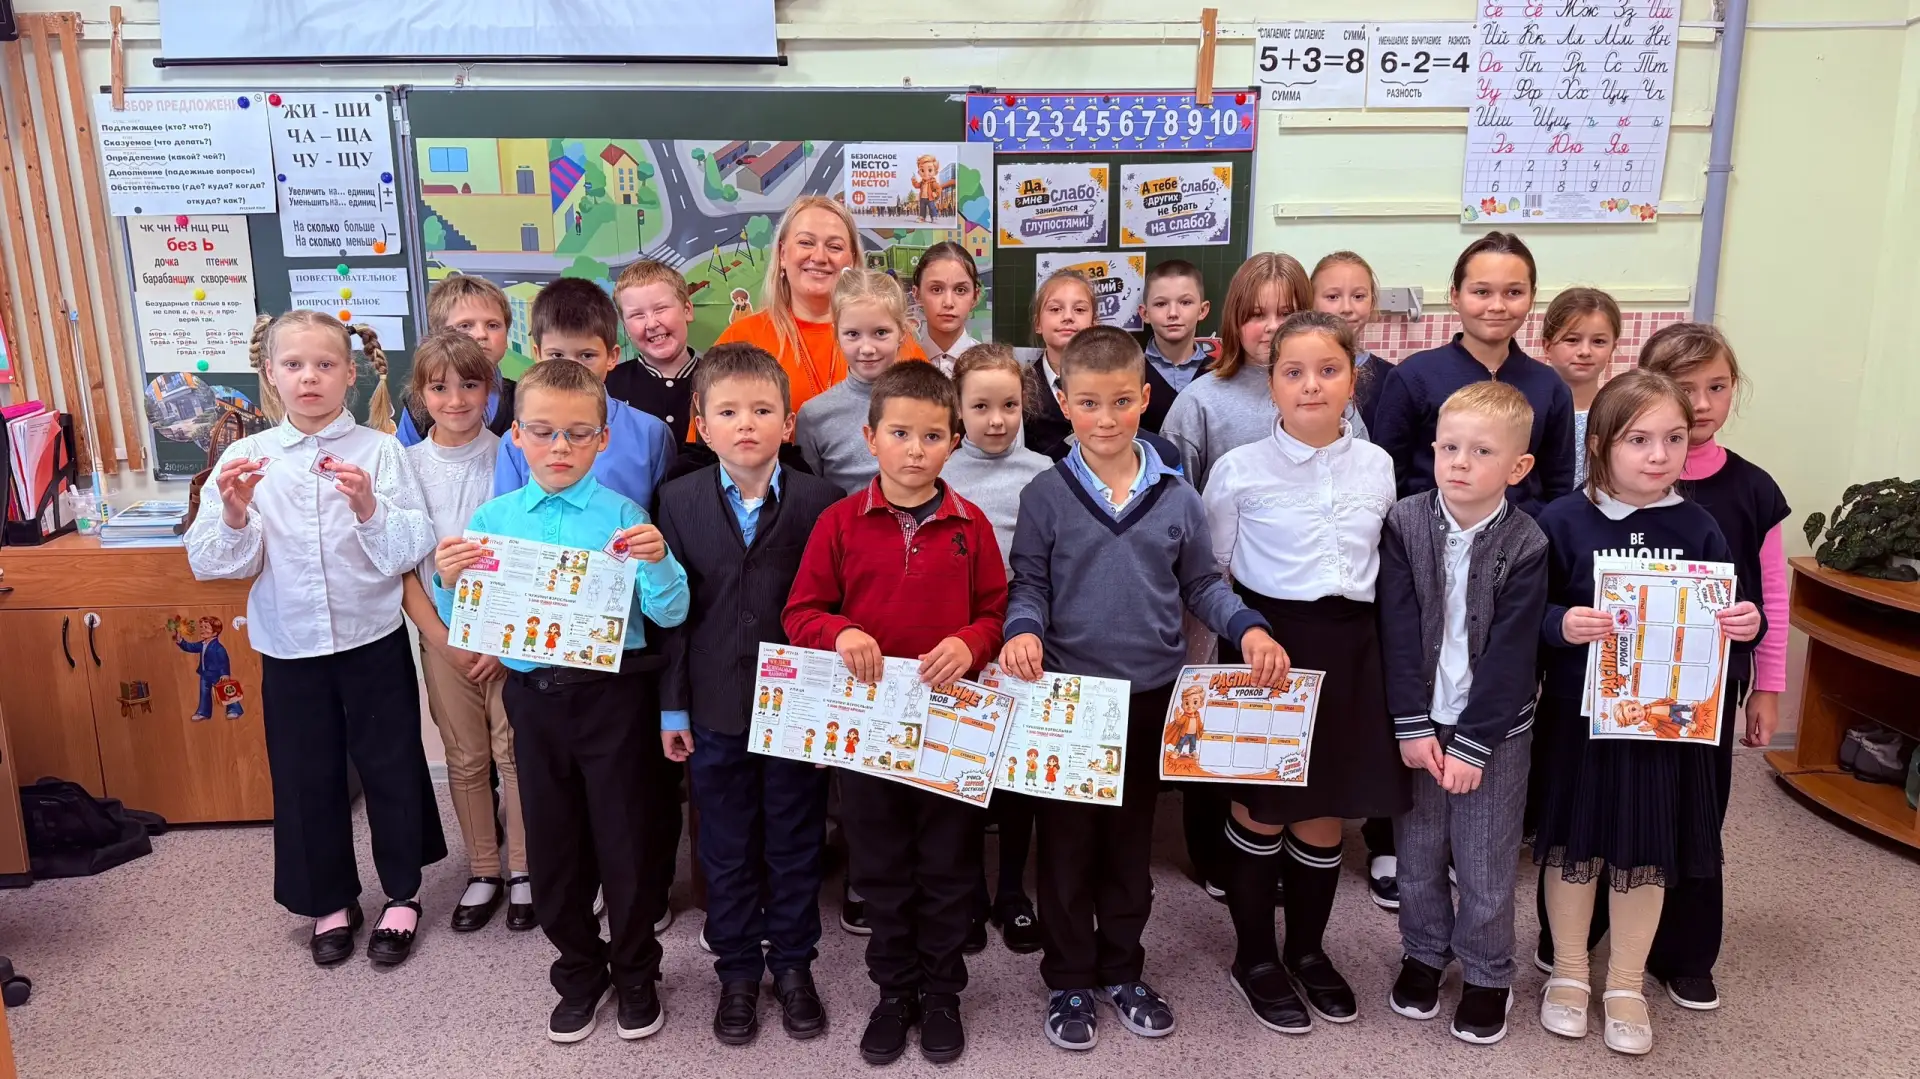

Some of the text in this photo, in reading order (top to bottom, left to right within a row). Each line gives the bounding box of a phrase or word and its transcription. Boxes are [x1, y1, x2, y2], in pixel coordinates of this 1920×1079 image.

[1260, 28, 1366, 41] СЛАГАЕМОЕ СЛАГАЕМОЕ СУММА
[1519, 25, 1546, 45] Кк
[1646, 25, 1671, 45] Нн
[1378, 36, 1471, 45] УМЕНЬШАЕМОЕ ВЫЧИТАЕМОЕ РАЗНОСТЬ
[1260, 46, 1364, 73] 5+3=8
[1381, 51, 1469, 73] 6-2=4
[1479, 52, 1503, 72] Оо
[1563, 52, 1586, 79] Рр
[1604, 52, 1622, 72] Сс
[1272, 91, 1301, 101] СУММА
[1387, 89, 1422, 98] РАЗНОСТЬ
[1477, 79, 1501, 105] Уу
[1514, 79, 1542, 106] Фф
[1558, 79, 1589, 99] Хх
[109, 100, 154, 112] ЗБОР
[282, 103, 372, 119] ЖИ ШИ
[189, 123, 211, 131] что?)
[983, 109, 1237, 137] 0 1 2 3 4 5 6 7 8 9 10
[287, 128, 373, 145] ЧА ЩА
[106, 153, 225, 162] Определение (какой? чей?)
[292, 152, 373, 169] ЧУ ЩУ
[851, 161, 889, 169] МЕСТО
[1527, 160, 1534, 171] 2
[1560, 160, 1567, 171] 3
[109, 168, 255, 177] Дополнение (падежные вопросы)
[851, 171, 896, 179] ЛЮДНОЕ
[182, 183, 205, 191] (где?
[208, 183, 233, 191] куда?
[236, 182, 265, 190] когда?
[852, 179, 889, 188] МЕСТО!
[1141, 184, 1150, 195] А
[1153, 179, 1177, 191] тебе
[1491, 181, 1499, 192] 6
[1557, 181, 1565, 192] 8
[1589, 181, 1597, 192] 9
[289, 187, 325, 196] Увеличить
[348, 189, 375, 197] единиц
[1023, 179, 1095, 201] Да, слабо
[223, 197, 246, 205] как?)
[289, 198, 329, 206] Уменьшить
[349, 199, 376, 208] единиц
[1022, 195, 1043, 205] мне
[1148, 194, 1179, 206] других
[1035, 204, 1078, 215] заниматься
[1158, 202, 1198, 216] не брать
[192, 224, 209, 233] НЩ
[212, 224, 229, 233] РЩ
[293, 220, 375, 232] На сколько больше
[1025, 216, 1089, 232] глупостями!
[1151, 216, 1211, 233] на слабо?
[167, 237, 197, 251] без
[295, 235, 306, 246] На
[309, 238, 341, 246] сколько
[155, 257, 238, 268] дочка птенчик
[1088, 267, 1104, 277] за
[143, 273, 247, 286] барабанщик скворечник
[295, 274, 398, 282] ПОВЕСТВОВАТЕЛЬНОЕ
[297, 298, 380, 306] ВОПРОСИТЕЛЬНОЕ
[1630, 532, 1644, 545] BE
[1620, 636, 1628, 667] УРОКОВ
[1235, 688, 1263, 696] УРОКОВ
